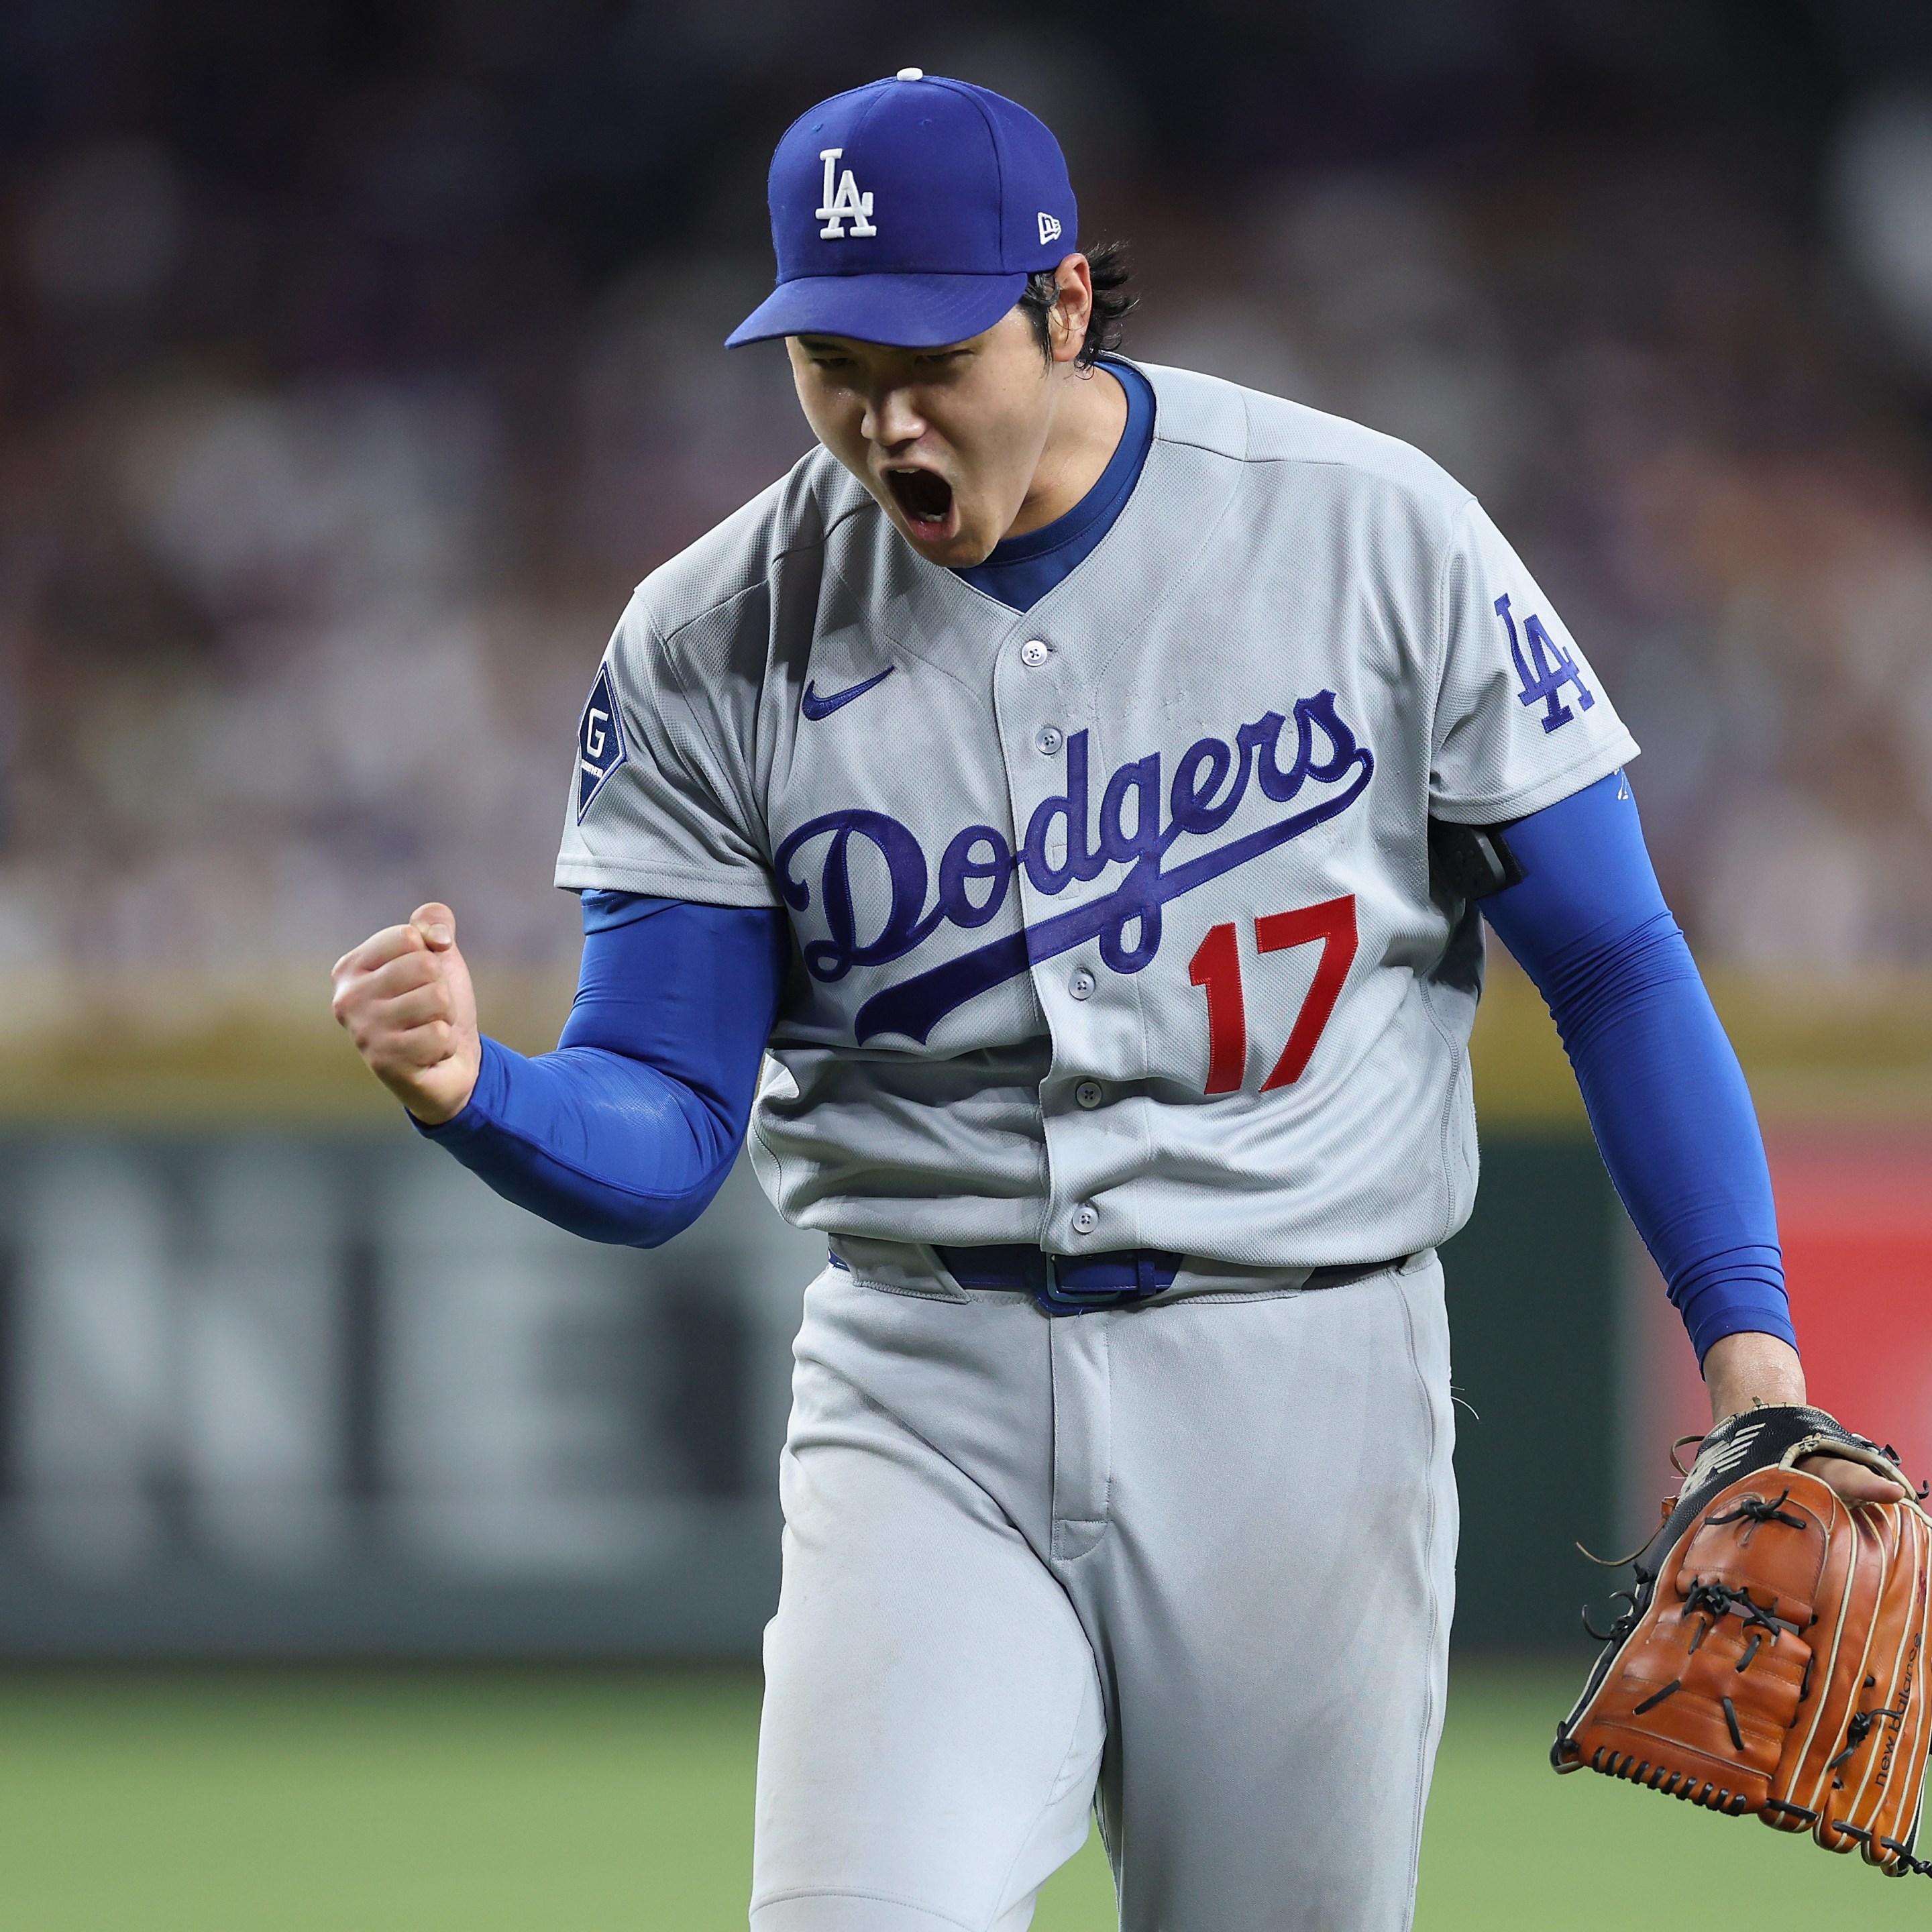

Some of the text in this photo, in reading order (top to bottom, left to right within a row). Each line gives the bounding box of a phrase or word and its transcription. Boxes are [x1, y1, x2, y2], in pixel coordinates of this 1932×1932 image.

[816, 148, 877, 239] LA
[586, 708, 608, 758] G
[1495, 593, 1595, 734] LA
[774, 690, 1373, 983] Dodgers
[1189, 894, 1358, 1094] 17
[1875, 1735, 1896, 1787] new
[1888, 1632, 1922, 1733] balance
